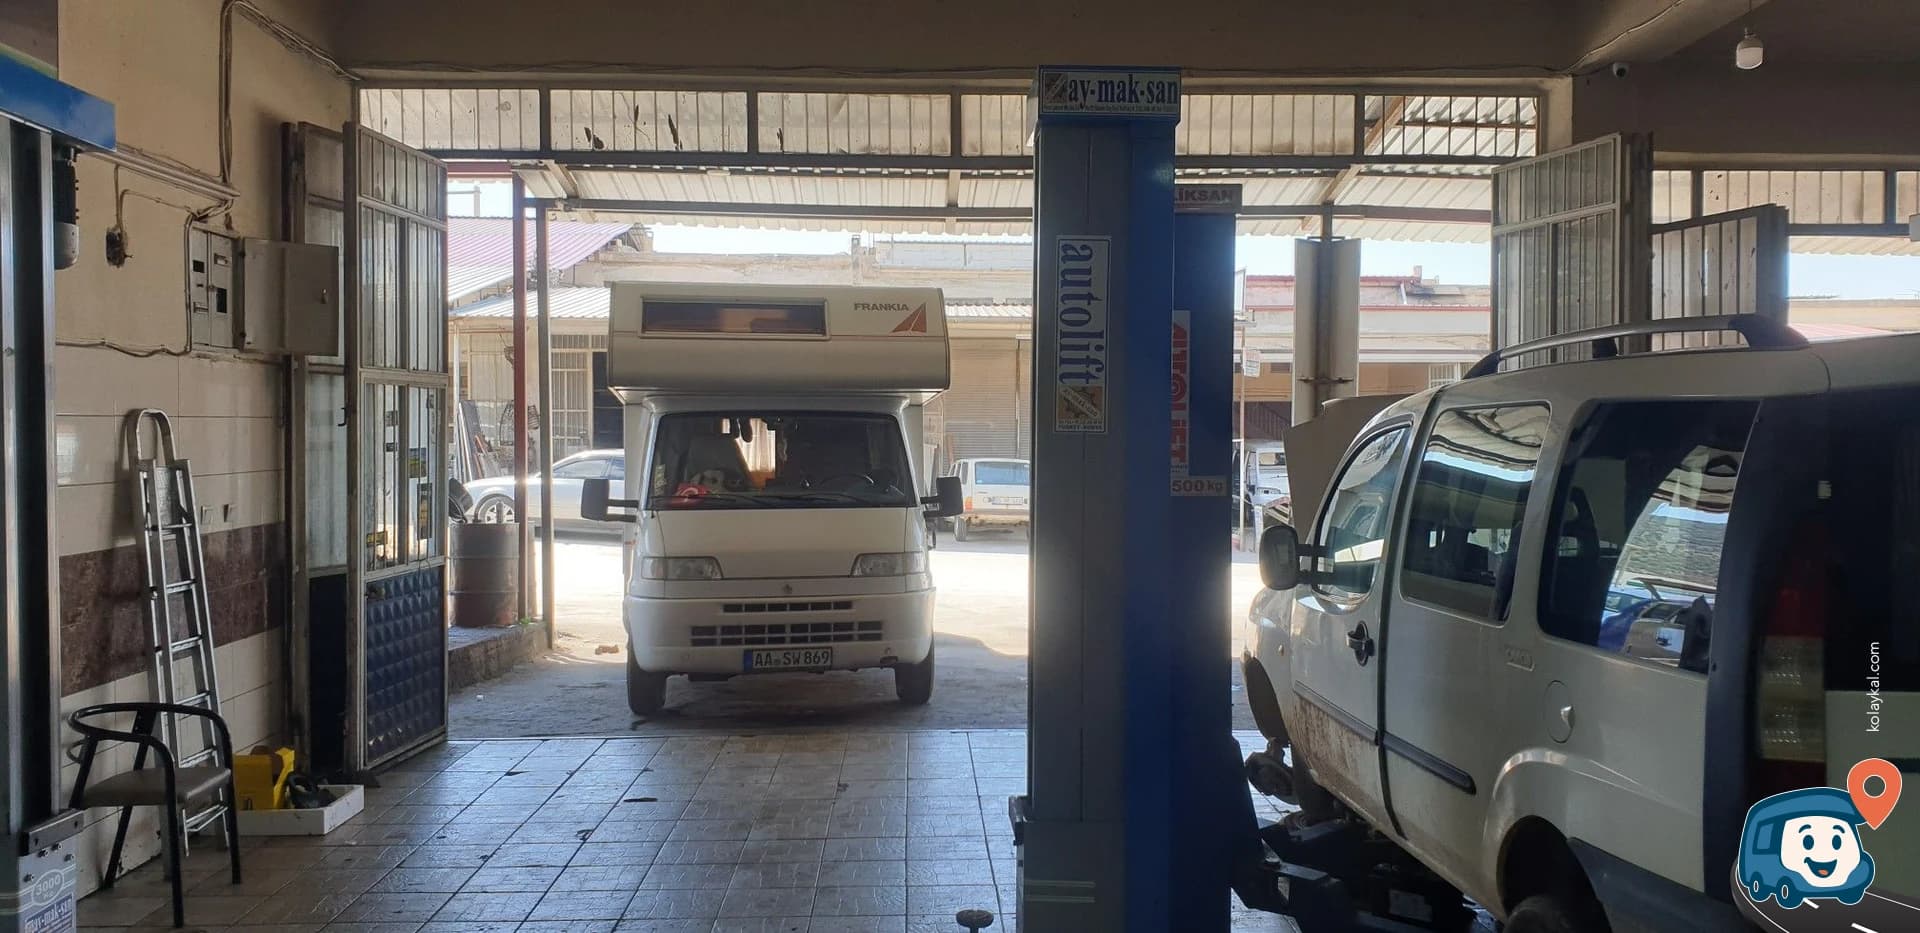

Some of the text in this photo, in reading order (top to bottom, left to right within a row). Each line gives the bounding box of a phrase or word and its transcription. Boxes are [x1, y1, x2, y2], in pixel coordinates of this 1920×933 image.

[853, 302, 910, 312] FRANKIA
[1058, 243, 1105, 385] autolift
[754, 650, 830, 667] AA SW 869
[35, 874, 61, 896] 3000
